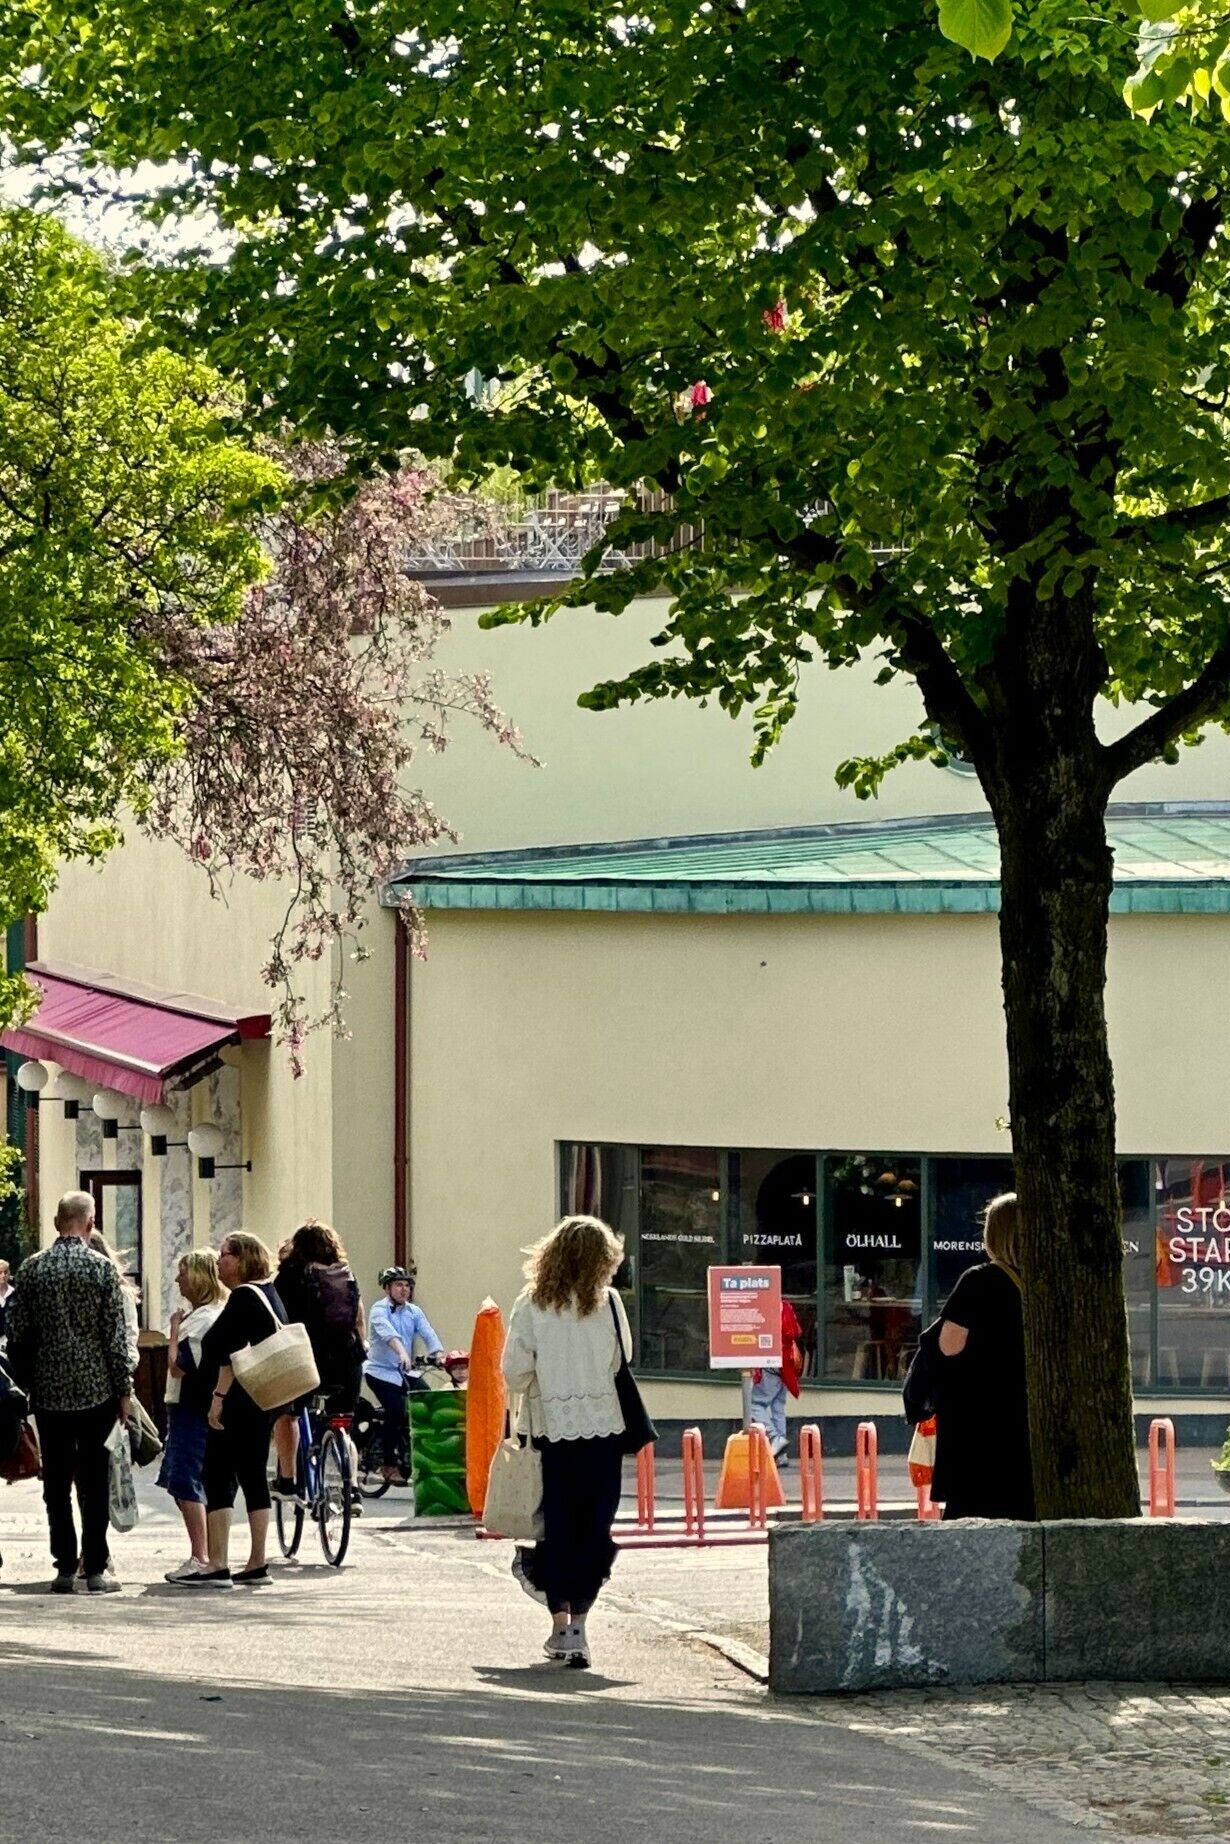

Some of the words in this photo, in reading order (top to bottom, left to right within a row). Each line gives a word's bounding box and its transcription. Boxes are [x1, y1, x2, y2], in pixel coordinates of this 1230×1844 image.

[846, 1233, 901, 1248] ÖLHALL
[723, 1278, 738, 1289] Ta
[740, 1277, 770, 1290] plats
